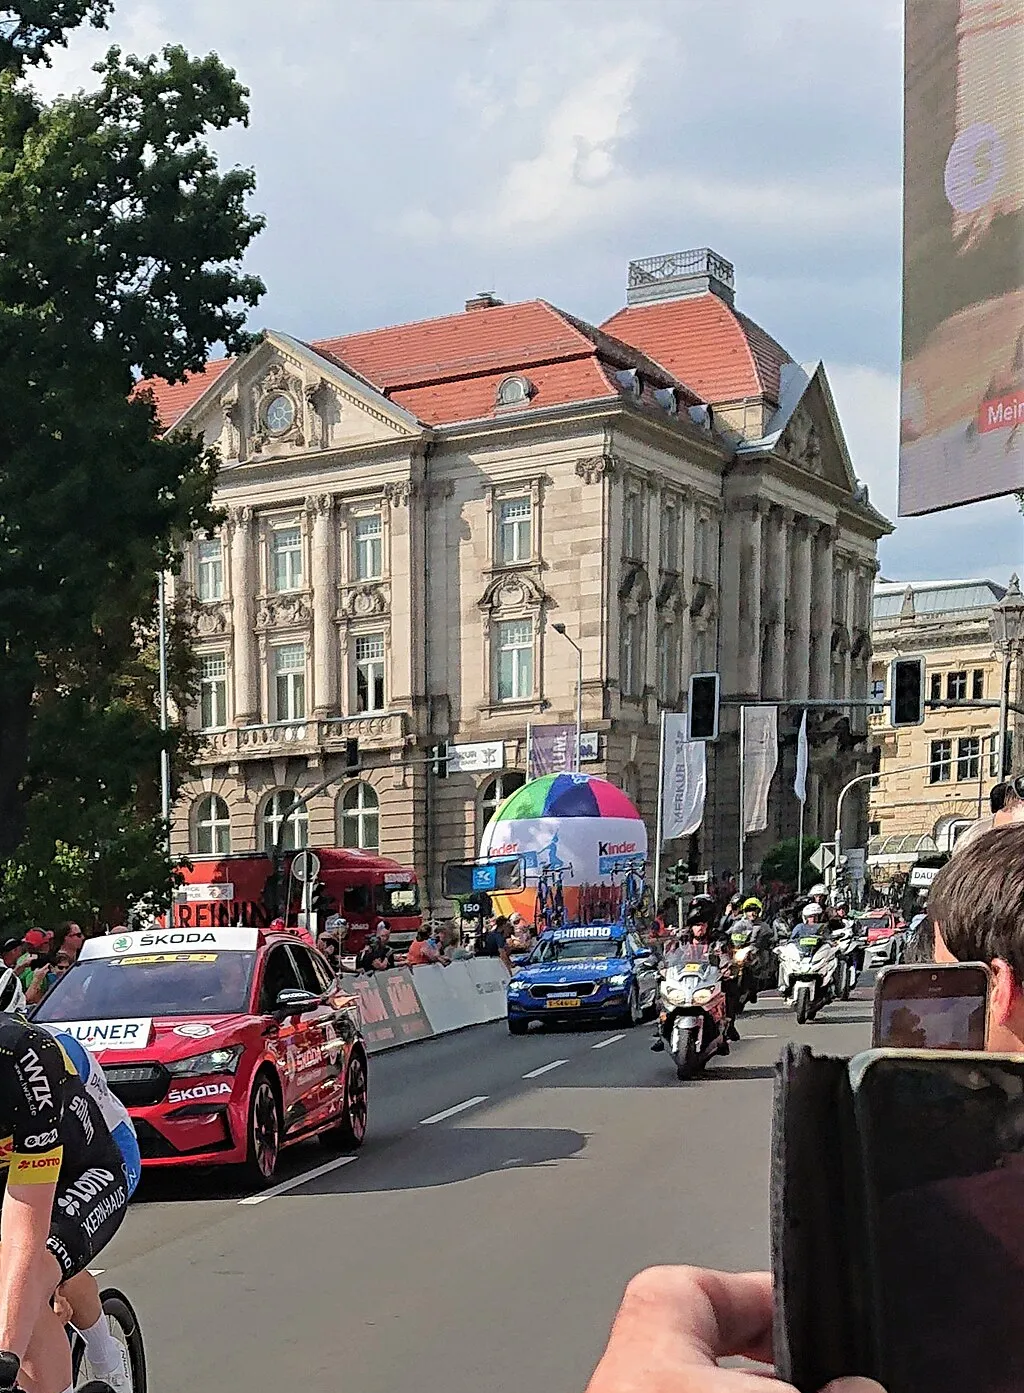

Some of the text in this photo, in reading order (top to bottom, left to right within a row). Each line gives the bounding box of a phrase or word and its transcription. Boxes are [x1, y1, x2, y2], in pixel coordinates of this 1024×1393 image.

[675, 762, 686, 824] MERKUR
[598, 841, 637, 856] Kinder
[462, 903, 480, 912] 150
[139, 931, 217, 946] ŠKODA
[553, 927, 611, 939] SHIMANO
[20, 1048, 54, 1112] TWZK
[167, 1081, 233, 1104] ŠKODA
[32, 1157, 60, 1169] LOTTO
[65, 1167, 115, 1204] LOTTO
